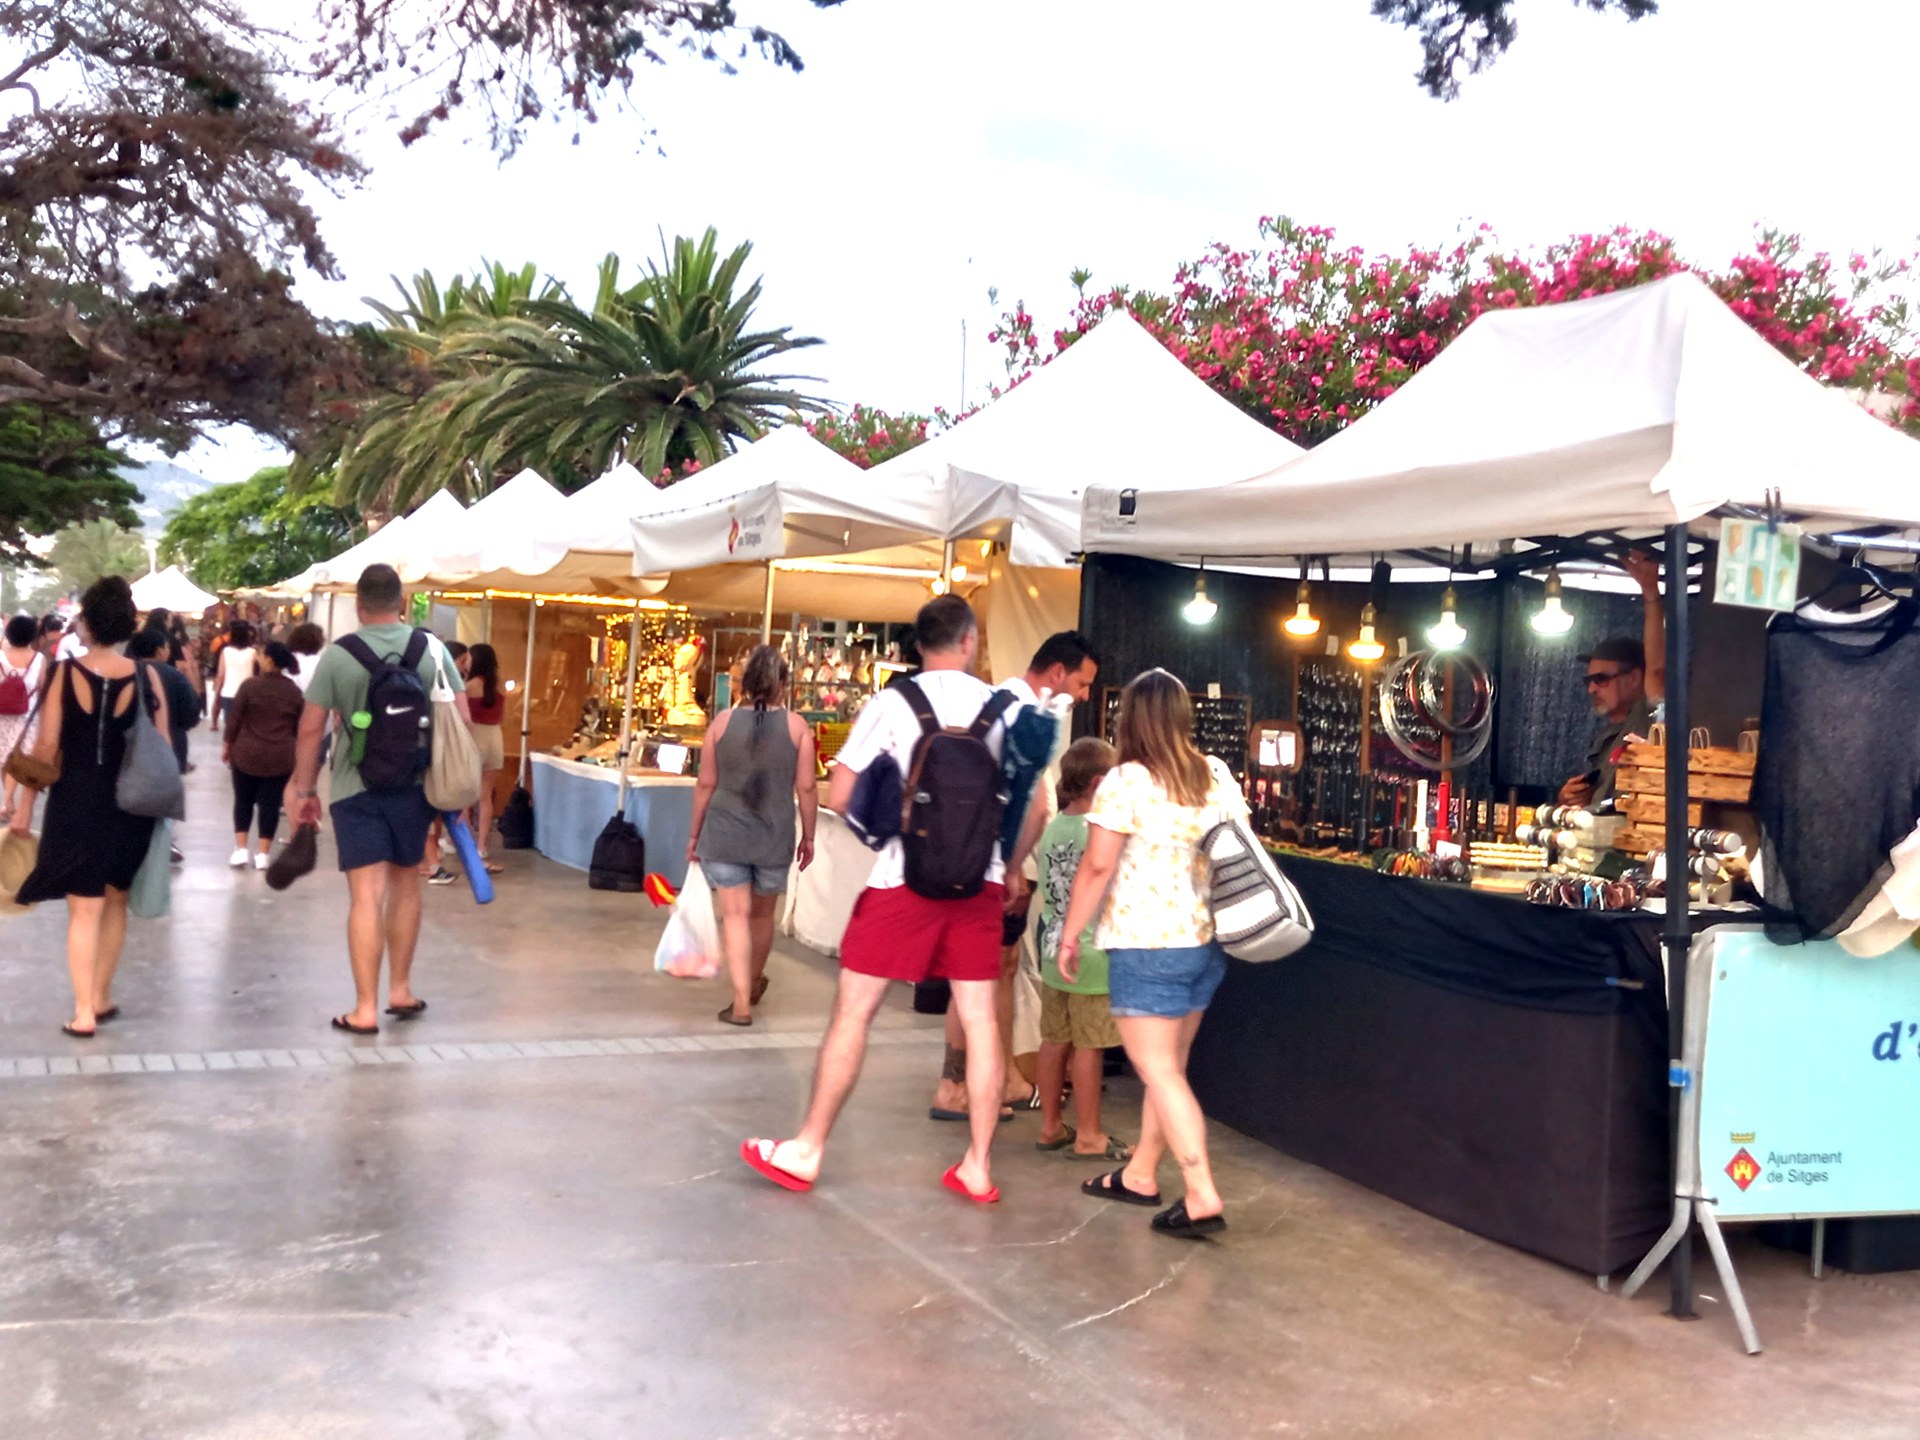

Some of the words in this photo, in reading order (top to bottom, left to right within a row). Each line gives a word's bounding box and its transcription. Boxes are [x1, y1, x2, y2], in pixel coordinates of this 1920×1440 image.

[1872, 1020, 1920, 1061] d'
[1767, 1151, 1842, 1168] Ajuntament
[1767, 1171, 1784, 1183] de
[1788, 1169, 1829, 1186] Sitges
